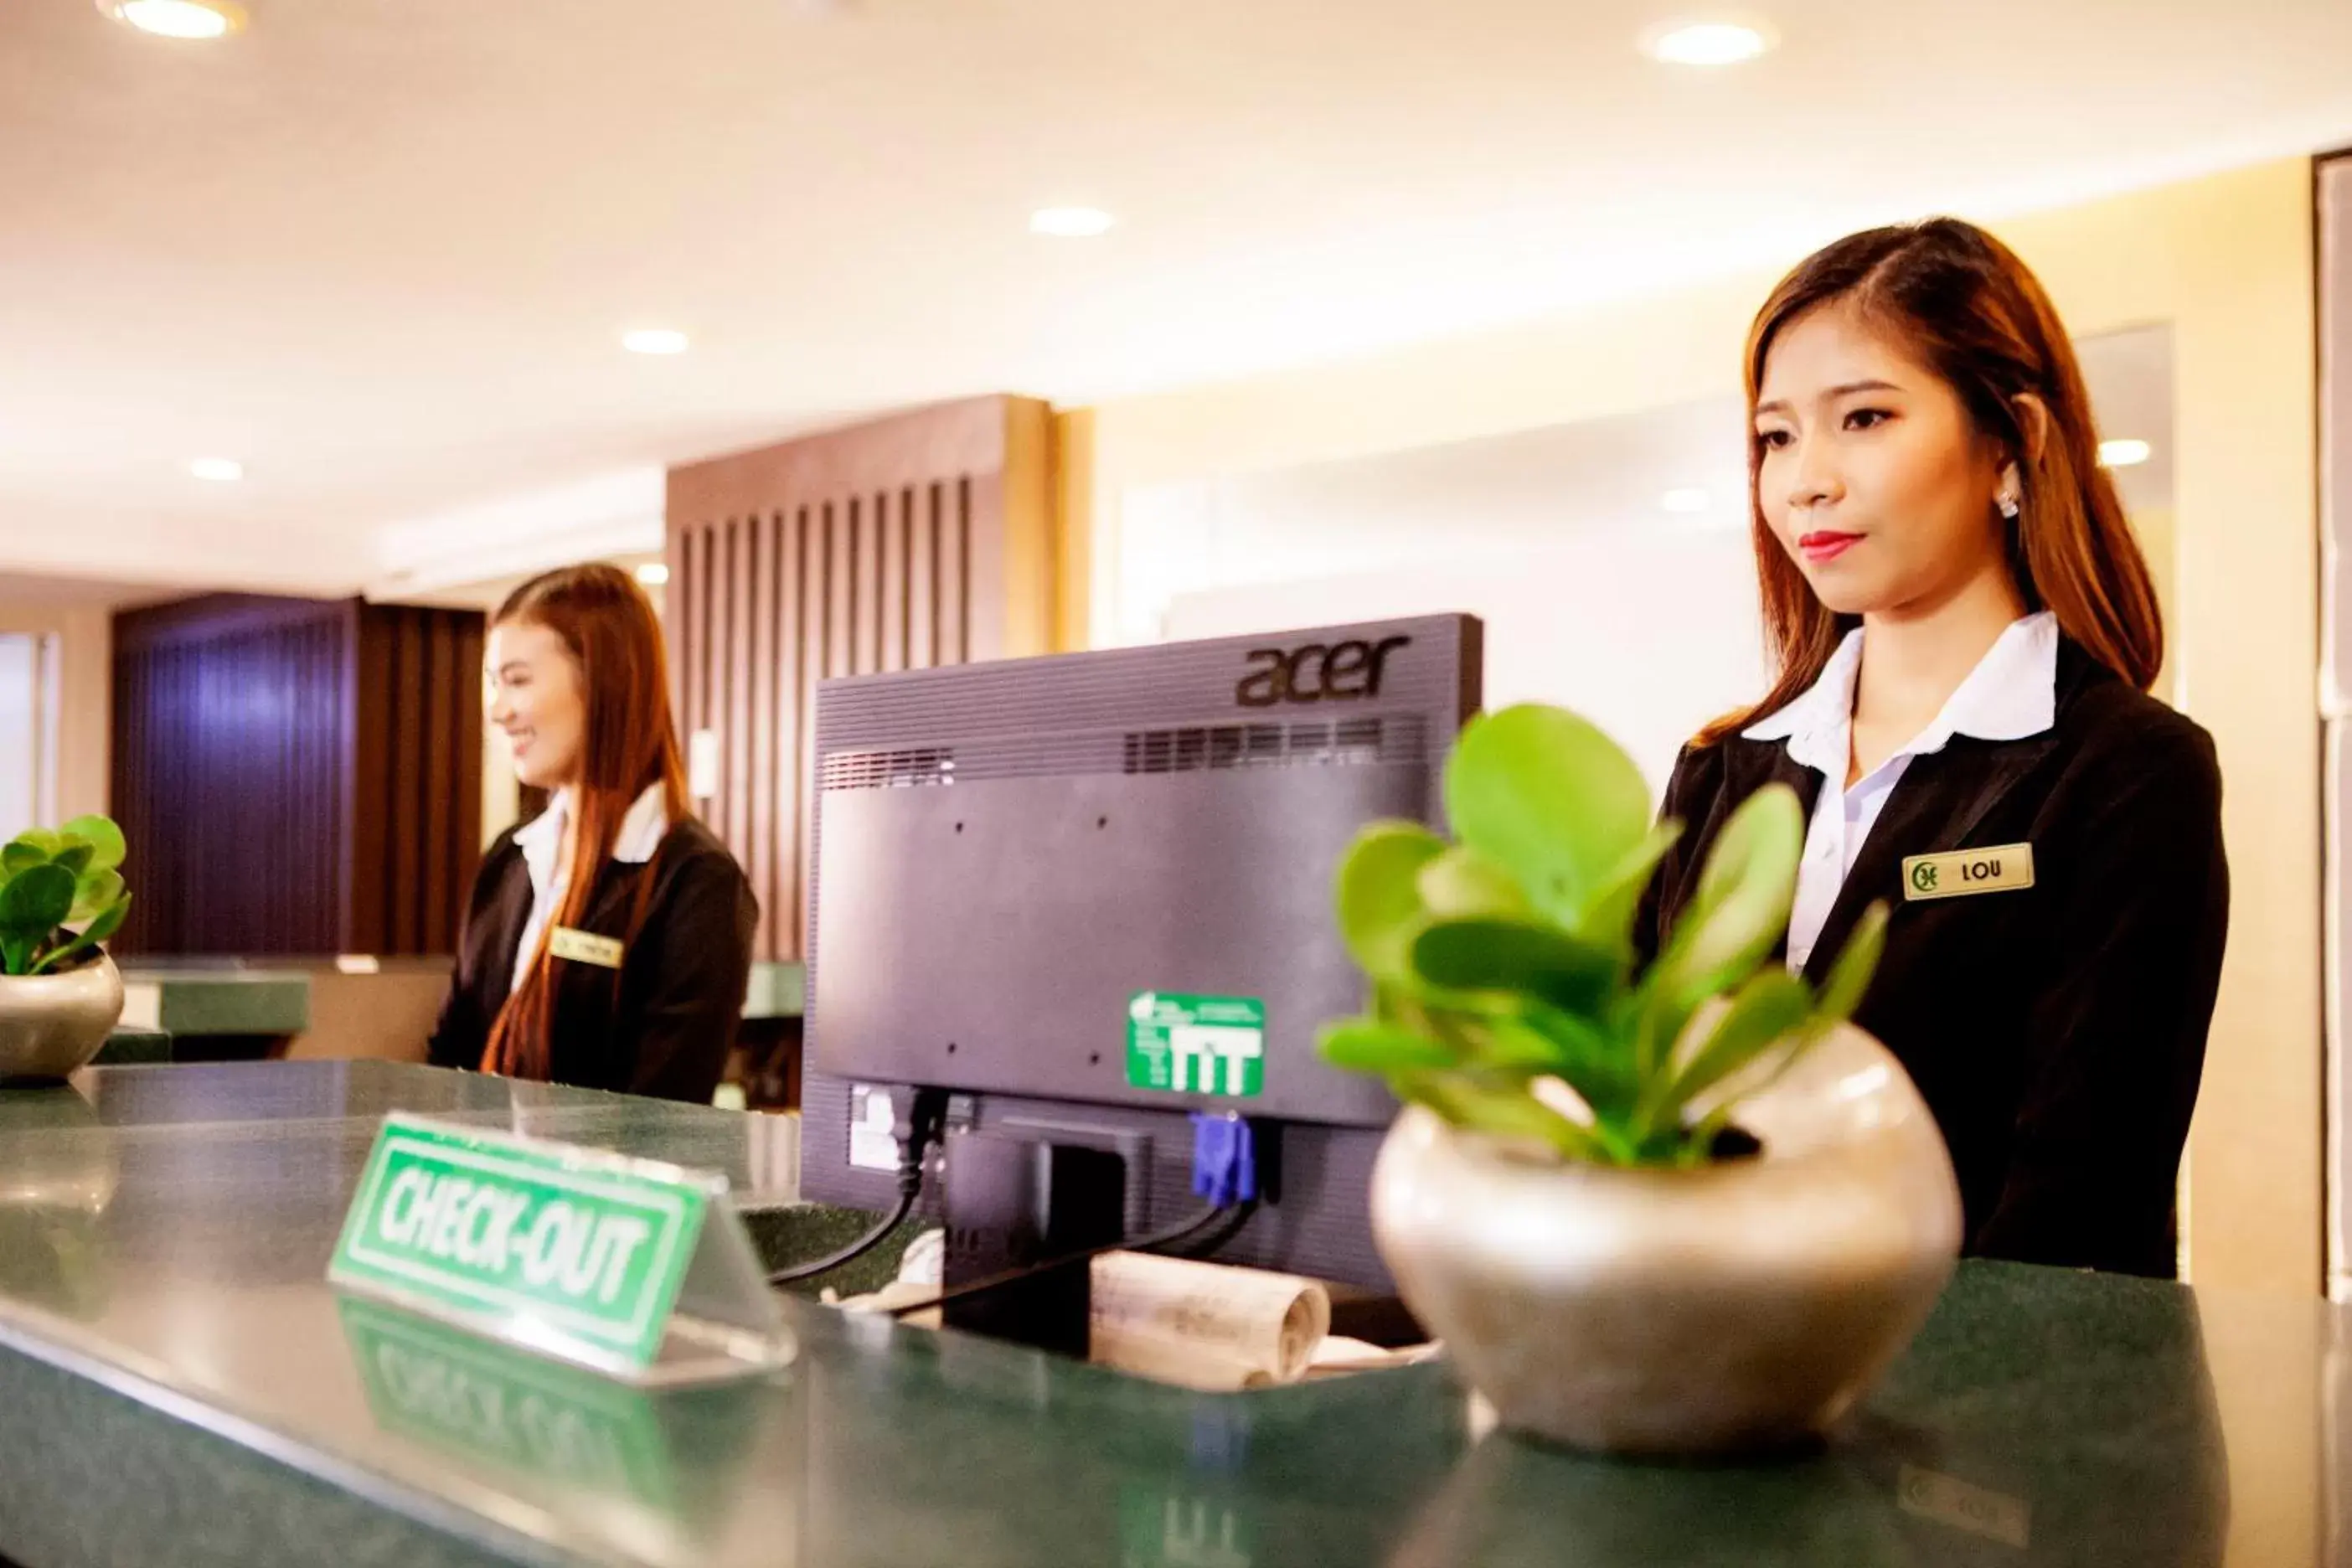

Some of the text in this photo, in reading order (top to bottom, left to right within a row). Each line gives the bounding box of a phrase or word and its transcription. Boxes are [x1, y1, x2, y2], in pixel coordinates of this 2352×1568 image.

[1236, 633, 1411, 706] acer
[1962, 859, 2002, 881] LOU
[380, 1166, 647, 1303] CHECK-OUT
